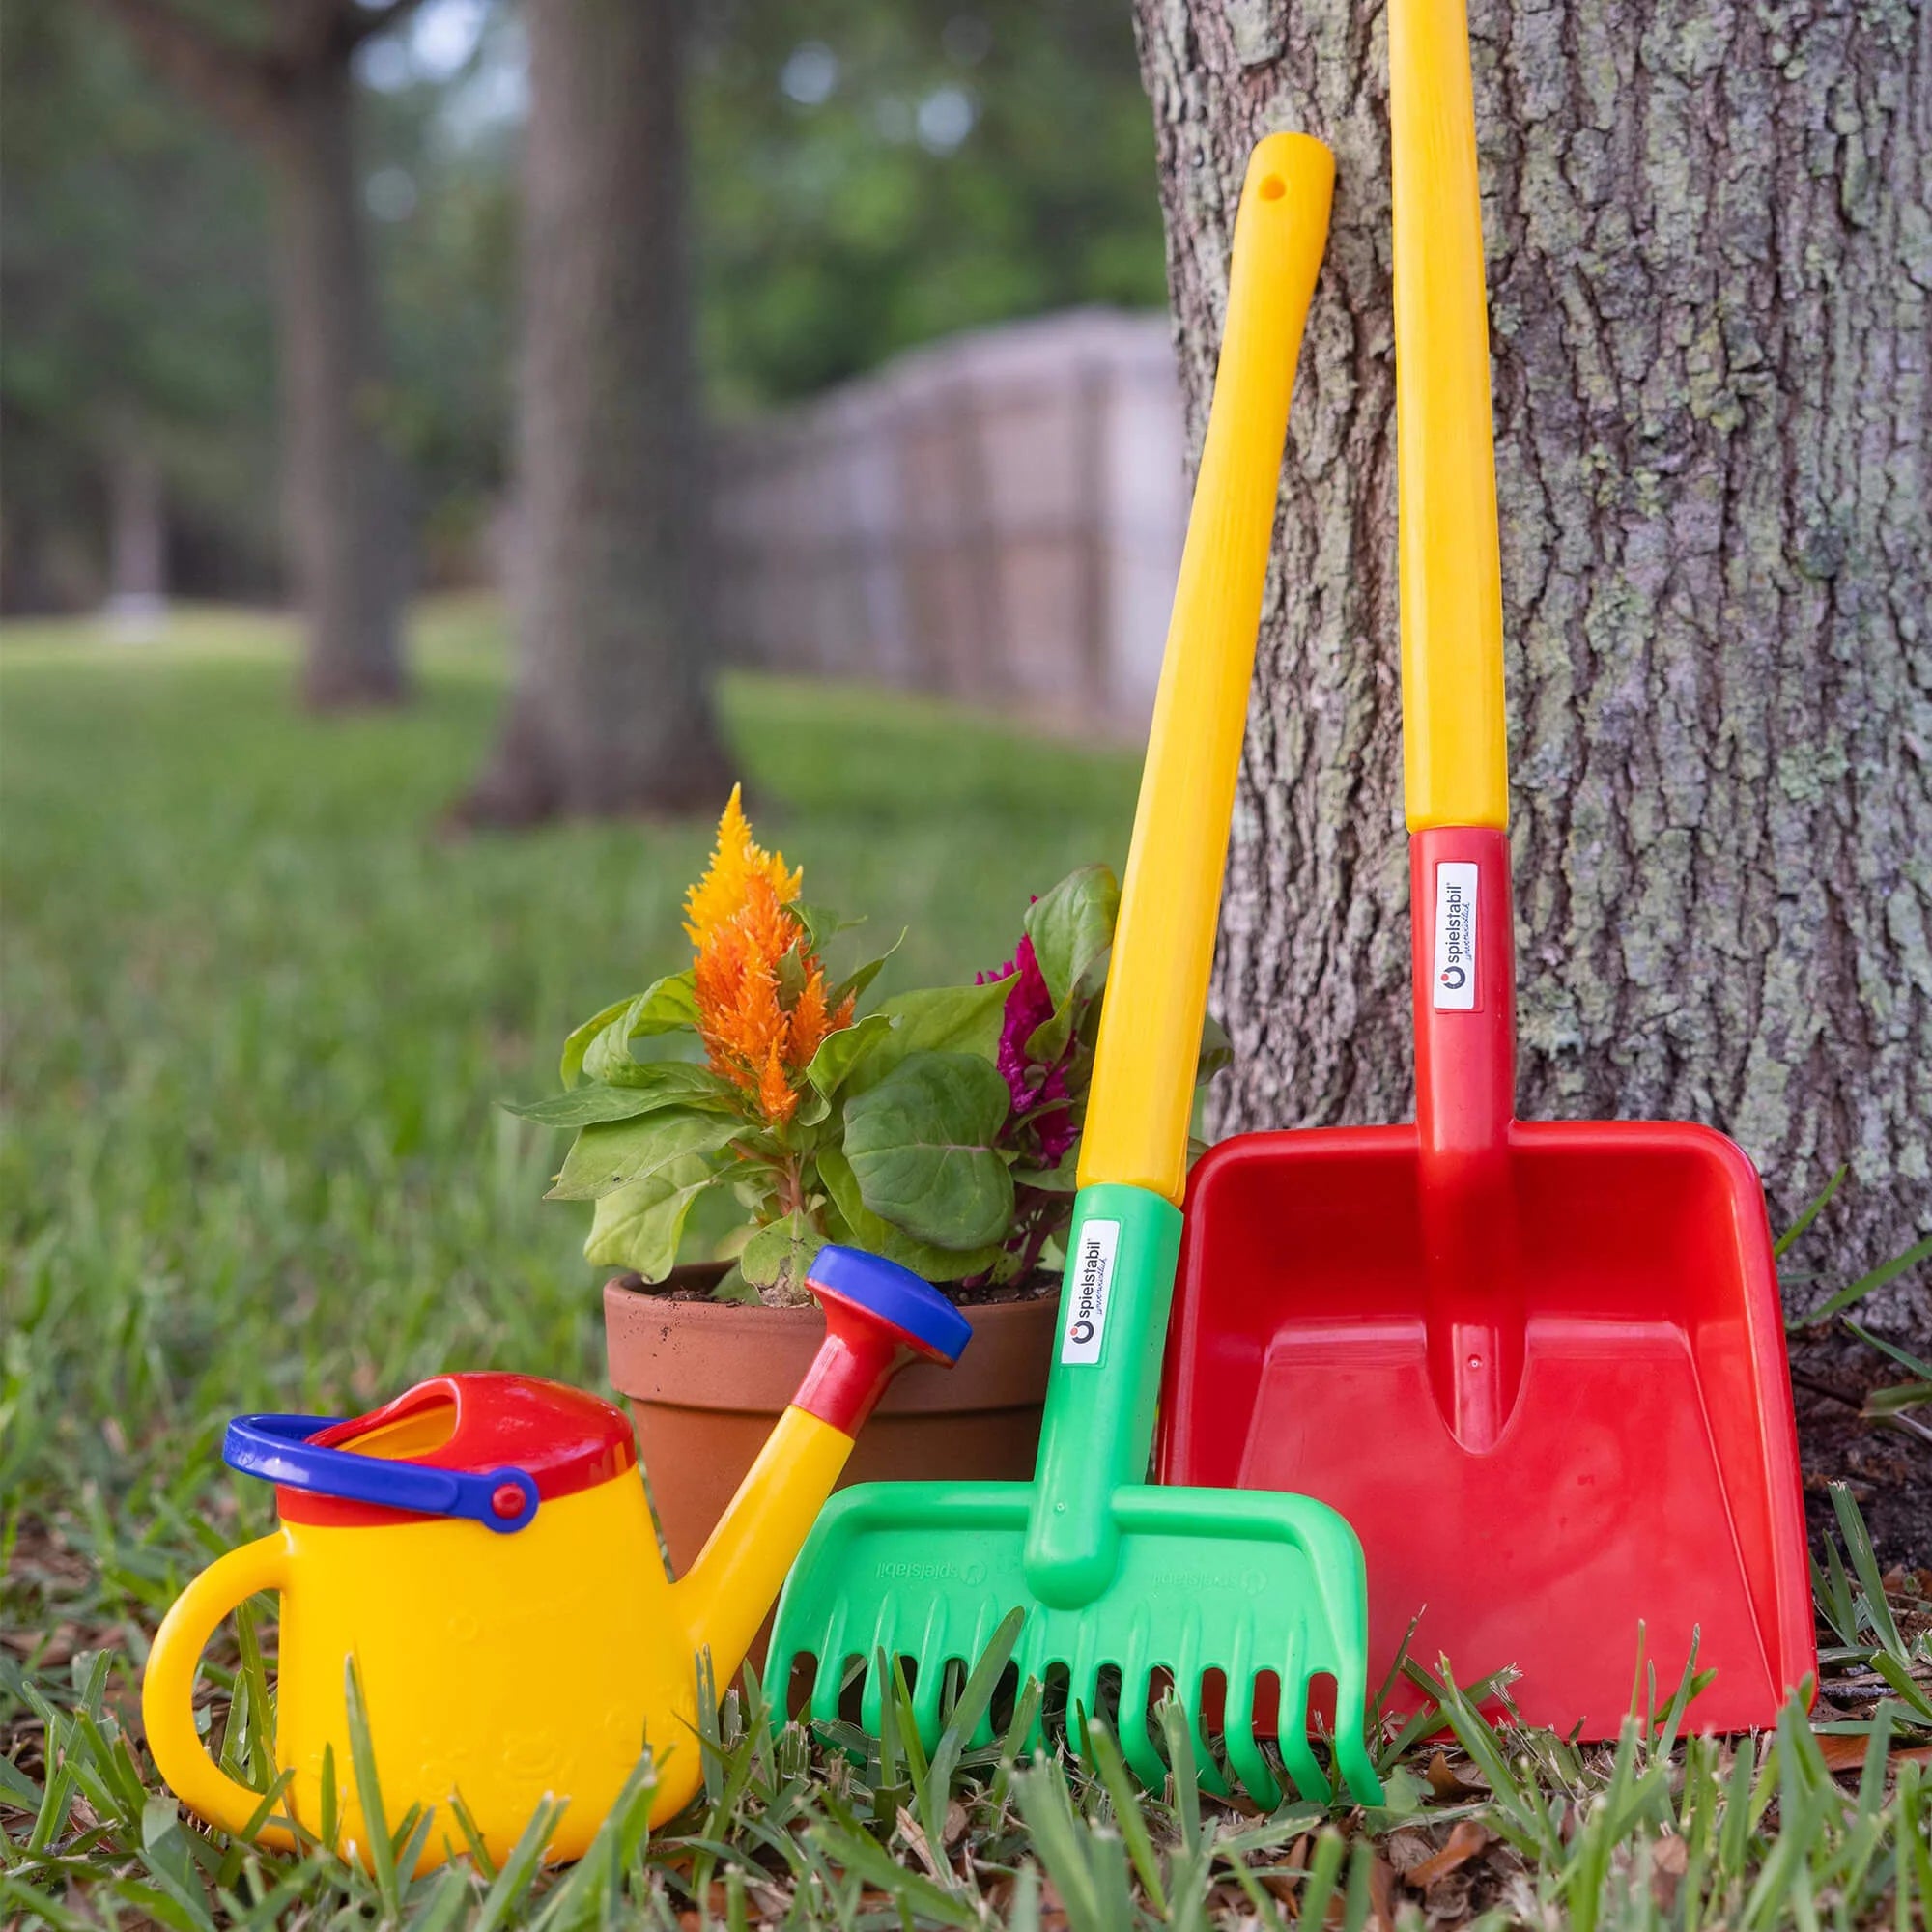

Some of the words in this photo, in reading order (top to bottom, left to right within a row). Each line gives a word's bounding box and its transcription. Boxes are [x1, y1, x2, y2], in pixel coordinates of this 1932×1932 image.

[1445, 885, 1463, 963] spielstabil
[1078, 1241, 1101, 1319] spielstabil
[875, 1562, 958, 1579] spielstabil
